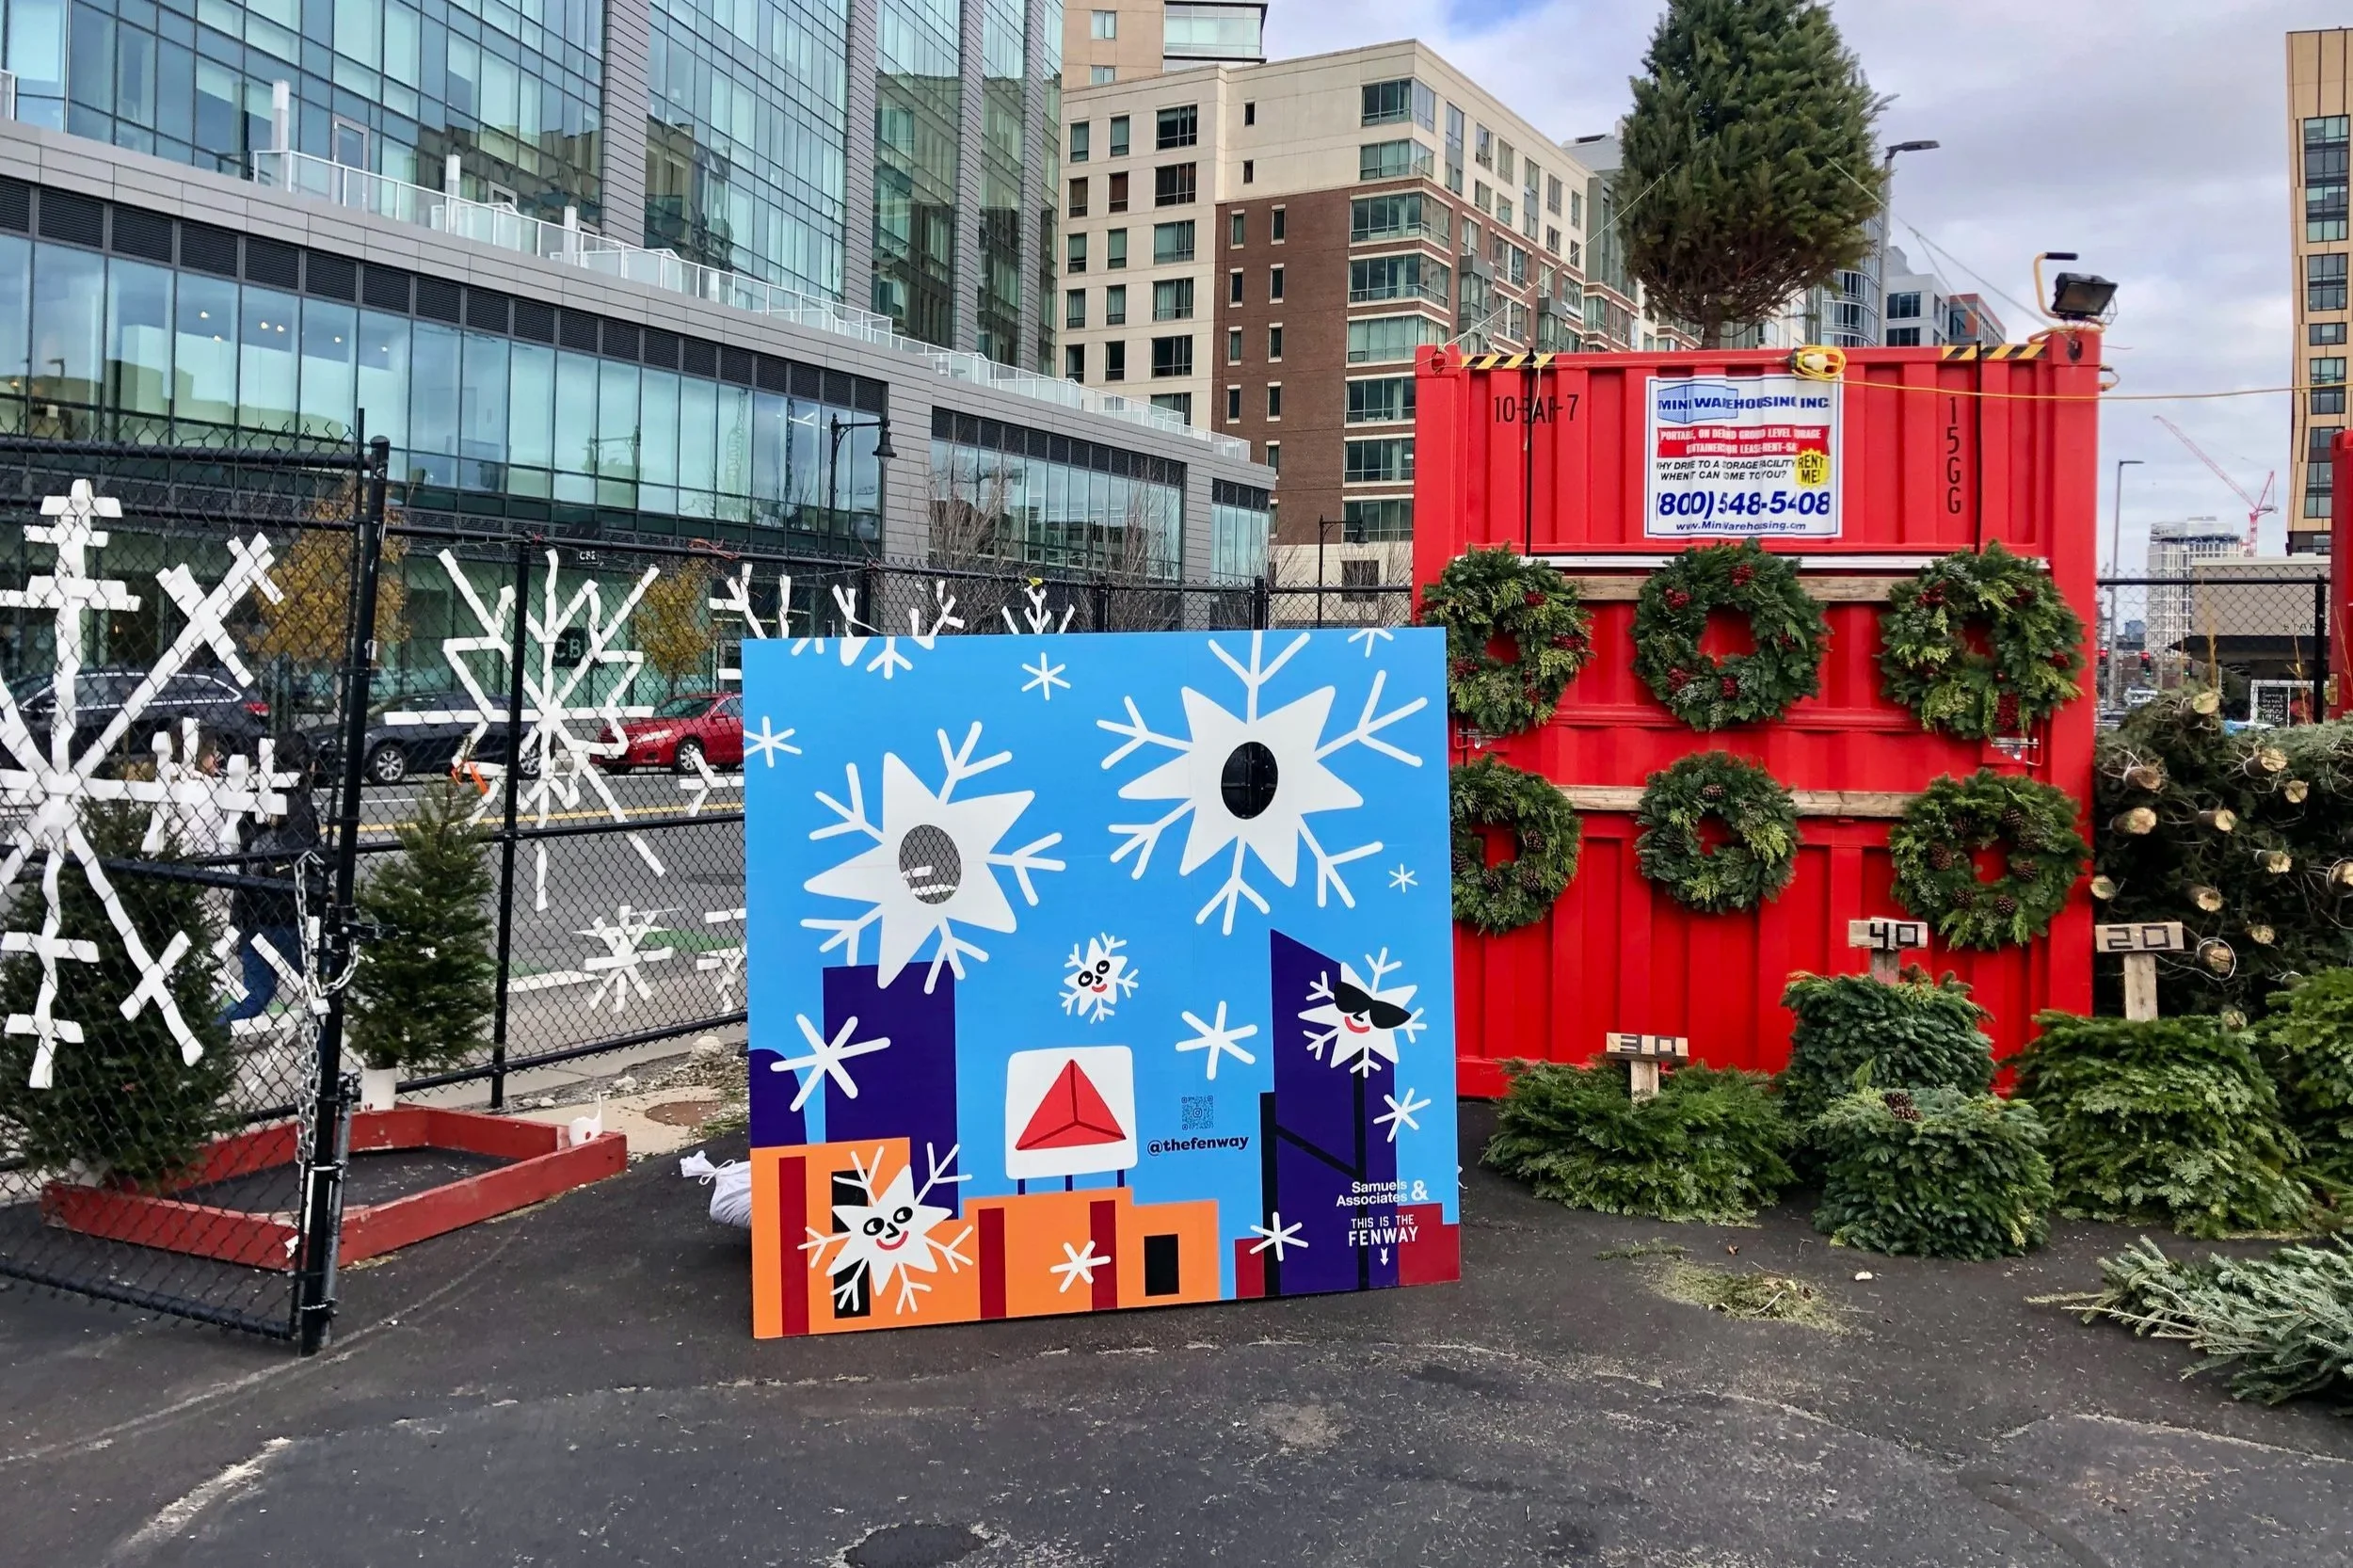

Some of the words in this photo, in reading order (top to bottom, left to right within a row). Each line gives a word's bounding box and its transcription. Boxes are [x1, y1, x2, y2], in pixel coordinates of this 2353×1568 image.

[1658, 400, 1691, 410] MINI
[1801, 397, 1831, 408] INC.
[1698, 429, 1709, 439] ON
[1768, 428, 1792, 438] LEVEL
[1699, 460, 1710, 469] TO
[1798, 455, 1824, 469] RENT
[1801, 470, 1821, 484] ME!
[1657, 491, 1715, 520] (800)
[1870, 921, 1918, 950] 40
[2107, 925, 2170, 950] 20
[1147, 1136, 1249, 1157] @thefenway
[1352, 1179, 1408, 1193] Samuels
[1411, 1179, 1430, 1202] &
[1337, 1192, 1408, 1207] Associates
[1351, 1217, 1374, 1229] THIS
[1379, 1216, 1389, 1227] IS
[1395, 1214, 1415, 1225] THE
[1348, 1225, 1418, 1247] FENWAY
